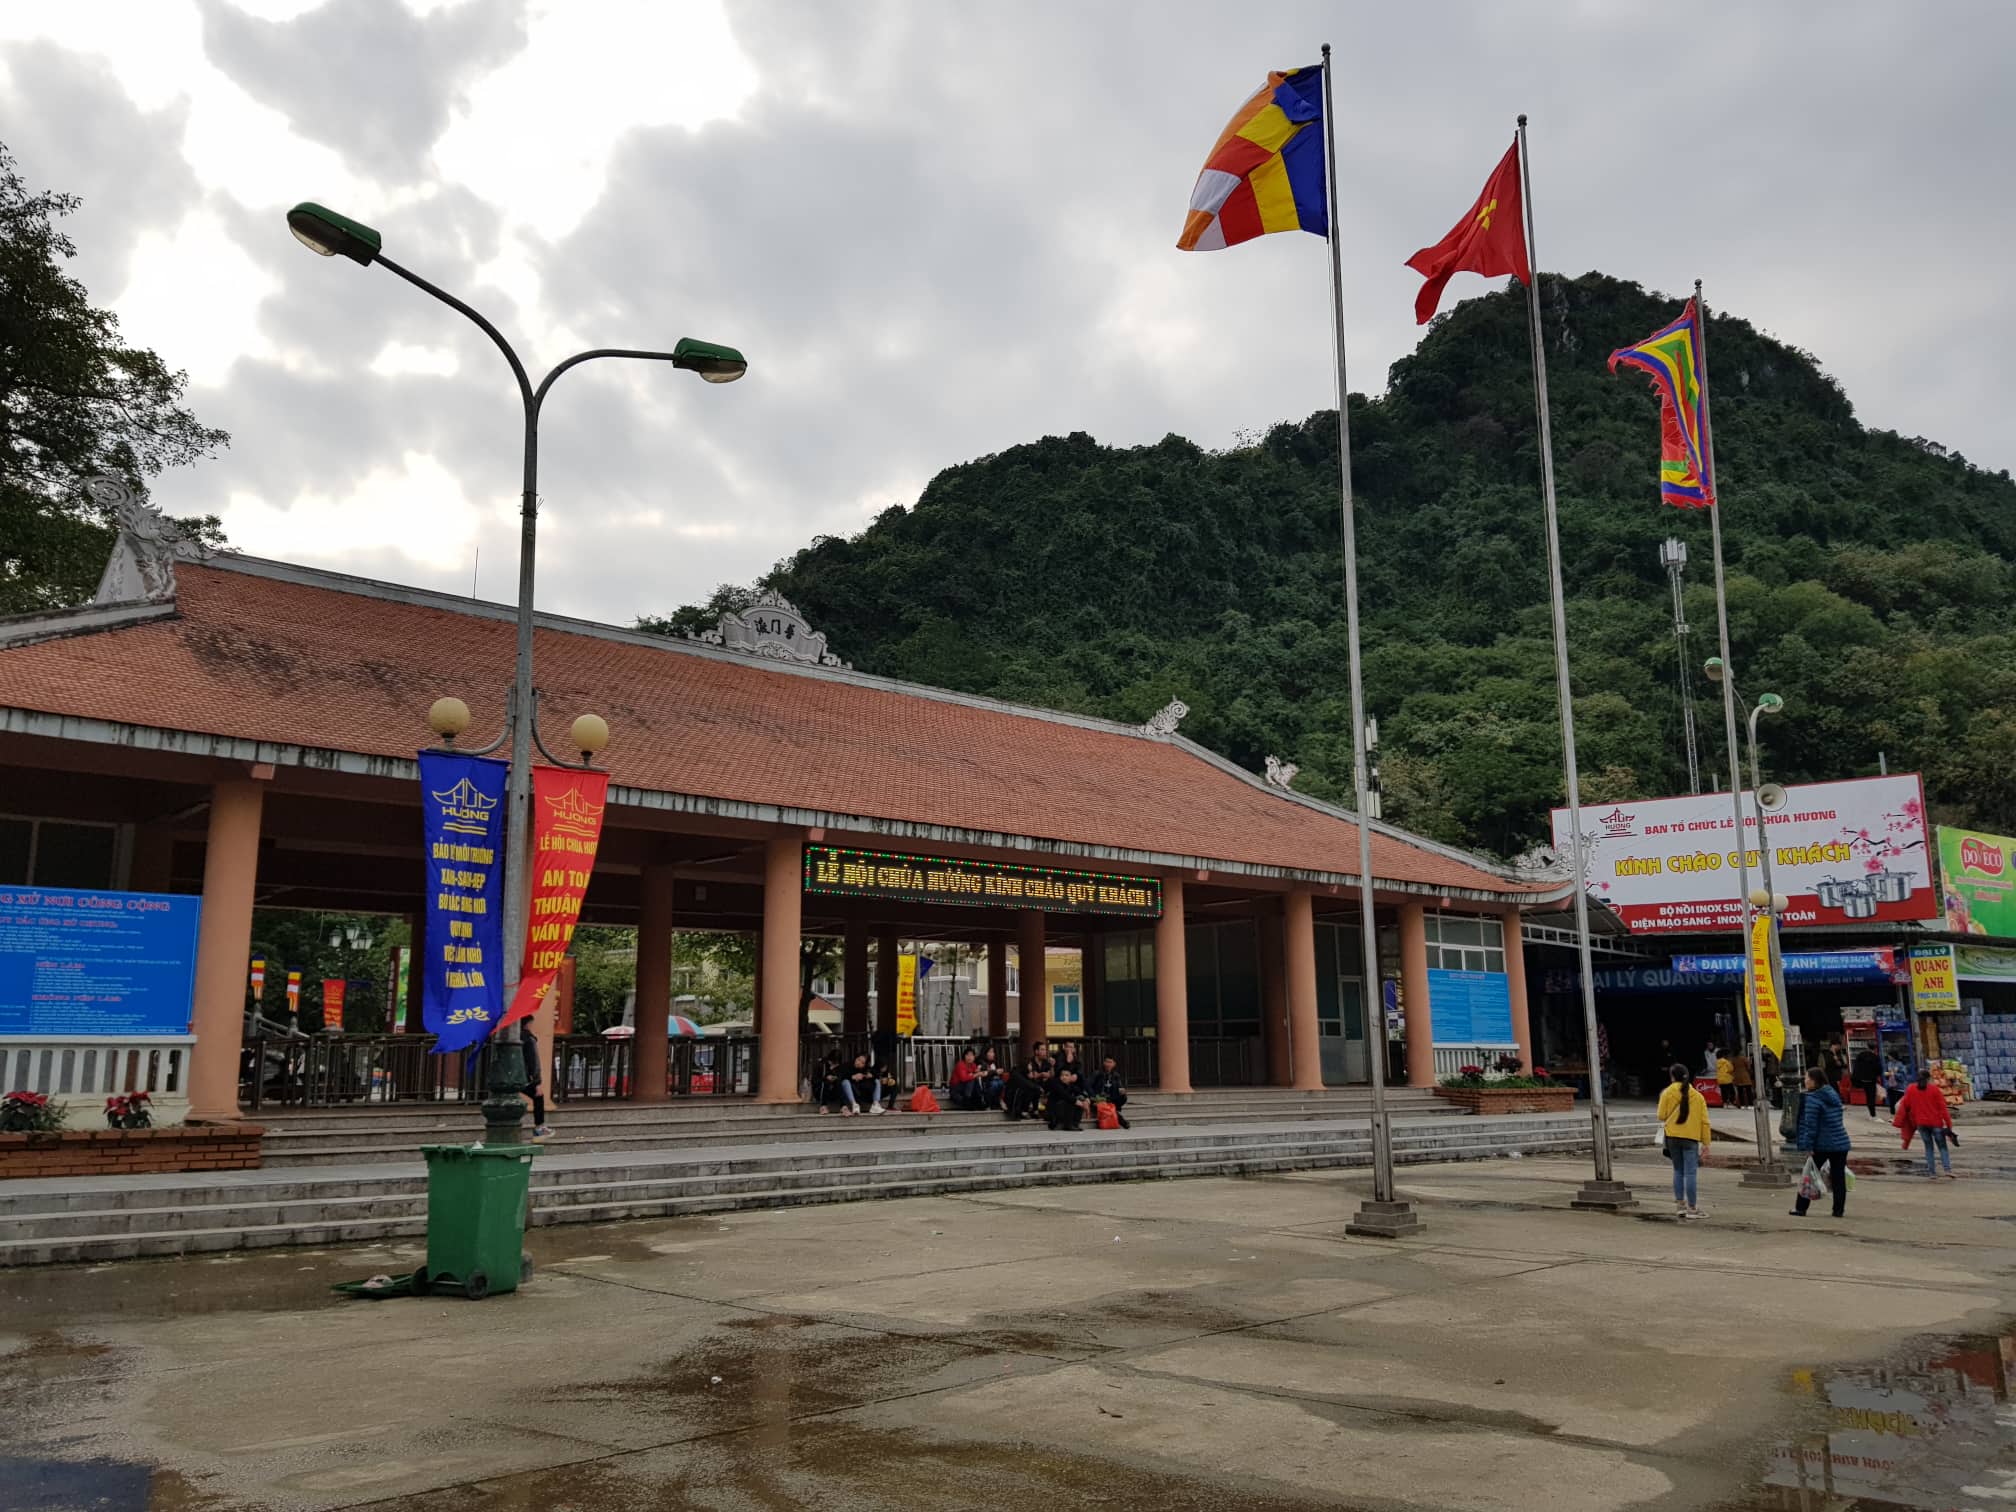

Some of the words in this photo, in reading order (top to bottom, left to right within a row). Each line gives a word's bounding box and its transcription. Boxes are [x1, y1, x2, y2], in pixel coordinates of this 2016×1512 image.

[1644, 825, 1668, 835] BAN
[1670, 819, 1685, 832] TỔ
[1688, 819, 1717, 831] CHỨC
[1720, 815, 1735, 829] LỄ
[1761, 812, 1791, 826] HÙA
[1793, 809, 1837, 823] HƯƠNG
[552, 834, 565, 853] HỘI
[1615, 855, 1662, 876] KÍNH
[1666, 850, 1721, 875] CHÀO
[1776, 841, 1851, 867] KHÁCH
[542, 869, 564, 887] AN
[816, 851, 840, 883] LỄ
[843, 859, 876, 888] HỘI
[878, 864, 924, 889] CHÙA
[927, 867, 982, 894] HƯƠNG
[984, 872, 1023, 897] KÍNH
[1025, 876, 1064, 899] CHÀO
[1066, 880, 1097, 905] QUÝ
[534, 893, 581, 917] THUẬN
[1659, 905, 1673, 917] BỘ
[1675, 902, 1694, 915] NỒI
[1696, 903, 1721, 914] INOX
[1631, 916, 1656, 930] DIỆN
[1656, 917, 1681, 930] MẠO
[1682, 915, 1711, 926] SANG
[1718, 914, 1745, 925] INOX
[1786, 910, 1816, 921] TOÀN
[1701, 957, 1722, 973] ĐẠI
[1726, 957, 1738, 970] LÝ
[1791, 958, 1818, 969] ANH
[1914, 959, 1949, 975] QUANG
[1593, 971, 1610, 993] ẠI
[1616, 965, 1636, 988] LÝ
[1643, 969, 1716, 987] QUANG
[1923, 977, 1945, 989] ANH
